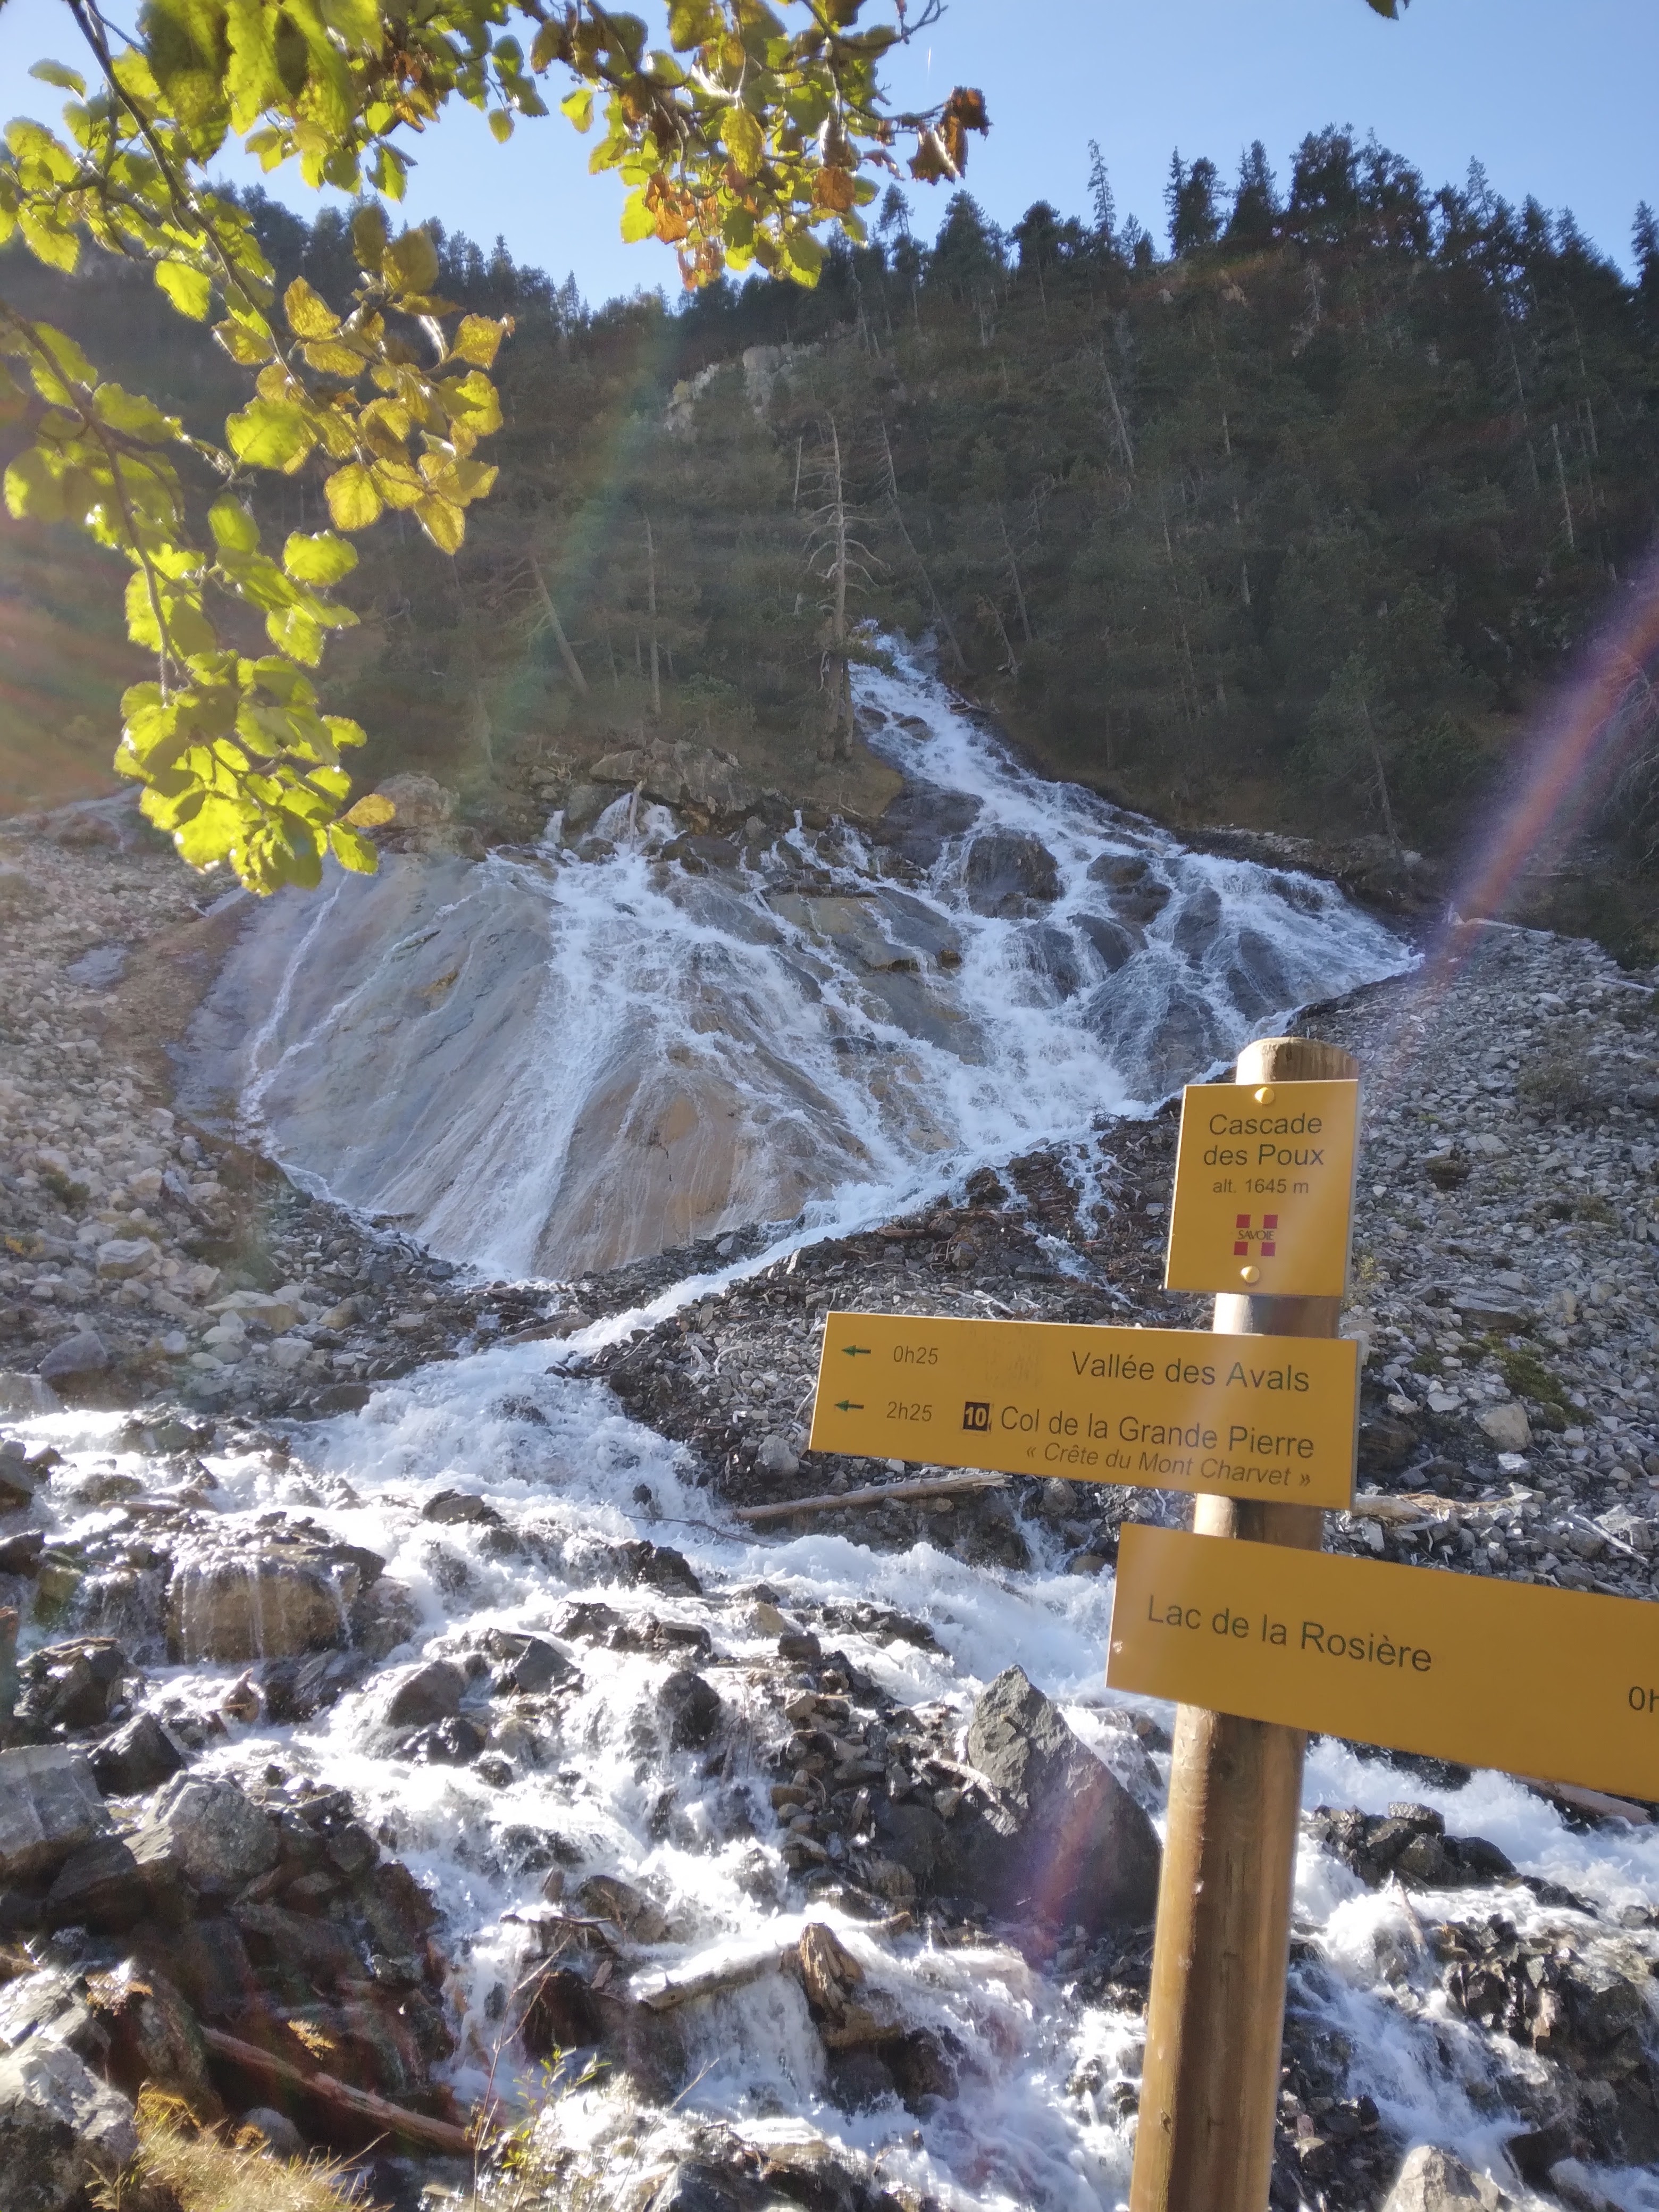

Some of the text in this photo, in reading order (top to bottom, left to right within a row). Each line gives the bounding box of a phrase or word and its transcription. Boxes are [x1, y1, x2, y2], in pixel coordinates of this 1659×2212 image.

[1209, 1112, 1322, 1136] Cascade
[1204, 1144, 1325, 1166] des Poux
[1212, 1178, 1309, 1193] alt. 1645 m
[1238, 1230, 1274, 1240] SAVOIE
[893, 1345, 938, 1364] 0h25
[1072, 1351, 1310, 1392] Vallée des Avals
[886, 1402, 932, 1422] 2h25
[965, 1406, 987, 1427] 10
[1001, 1406, 1314, 1459] Col de la Grande Pierre
[1026, 1443, 1311, 1486] « Crête du Mont Charvet »
[1148, 1594, 1432, 1672] Lac de la Rosière
